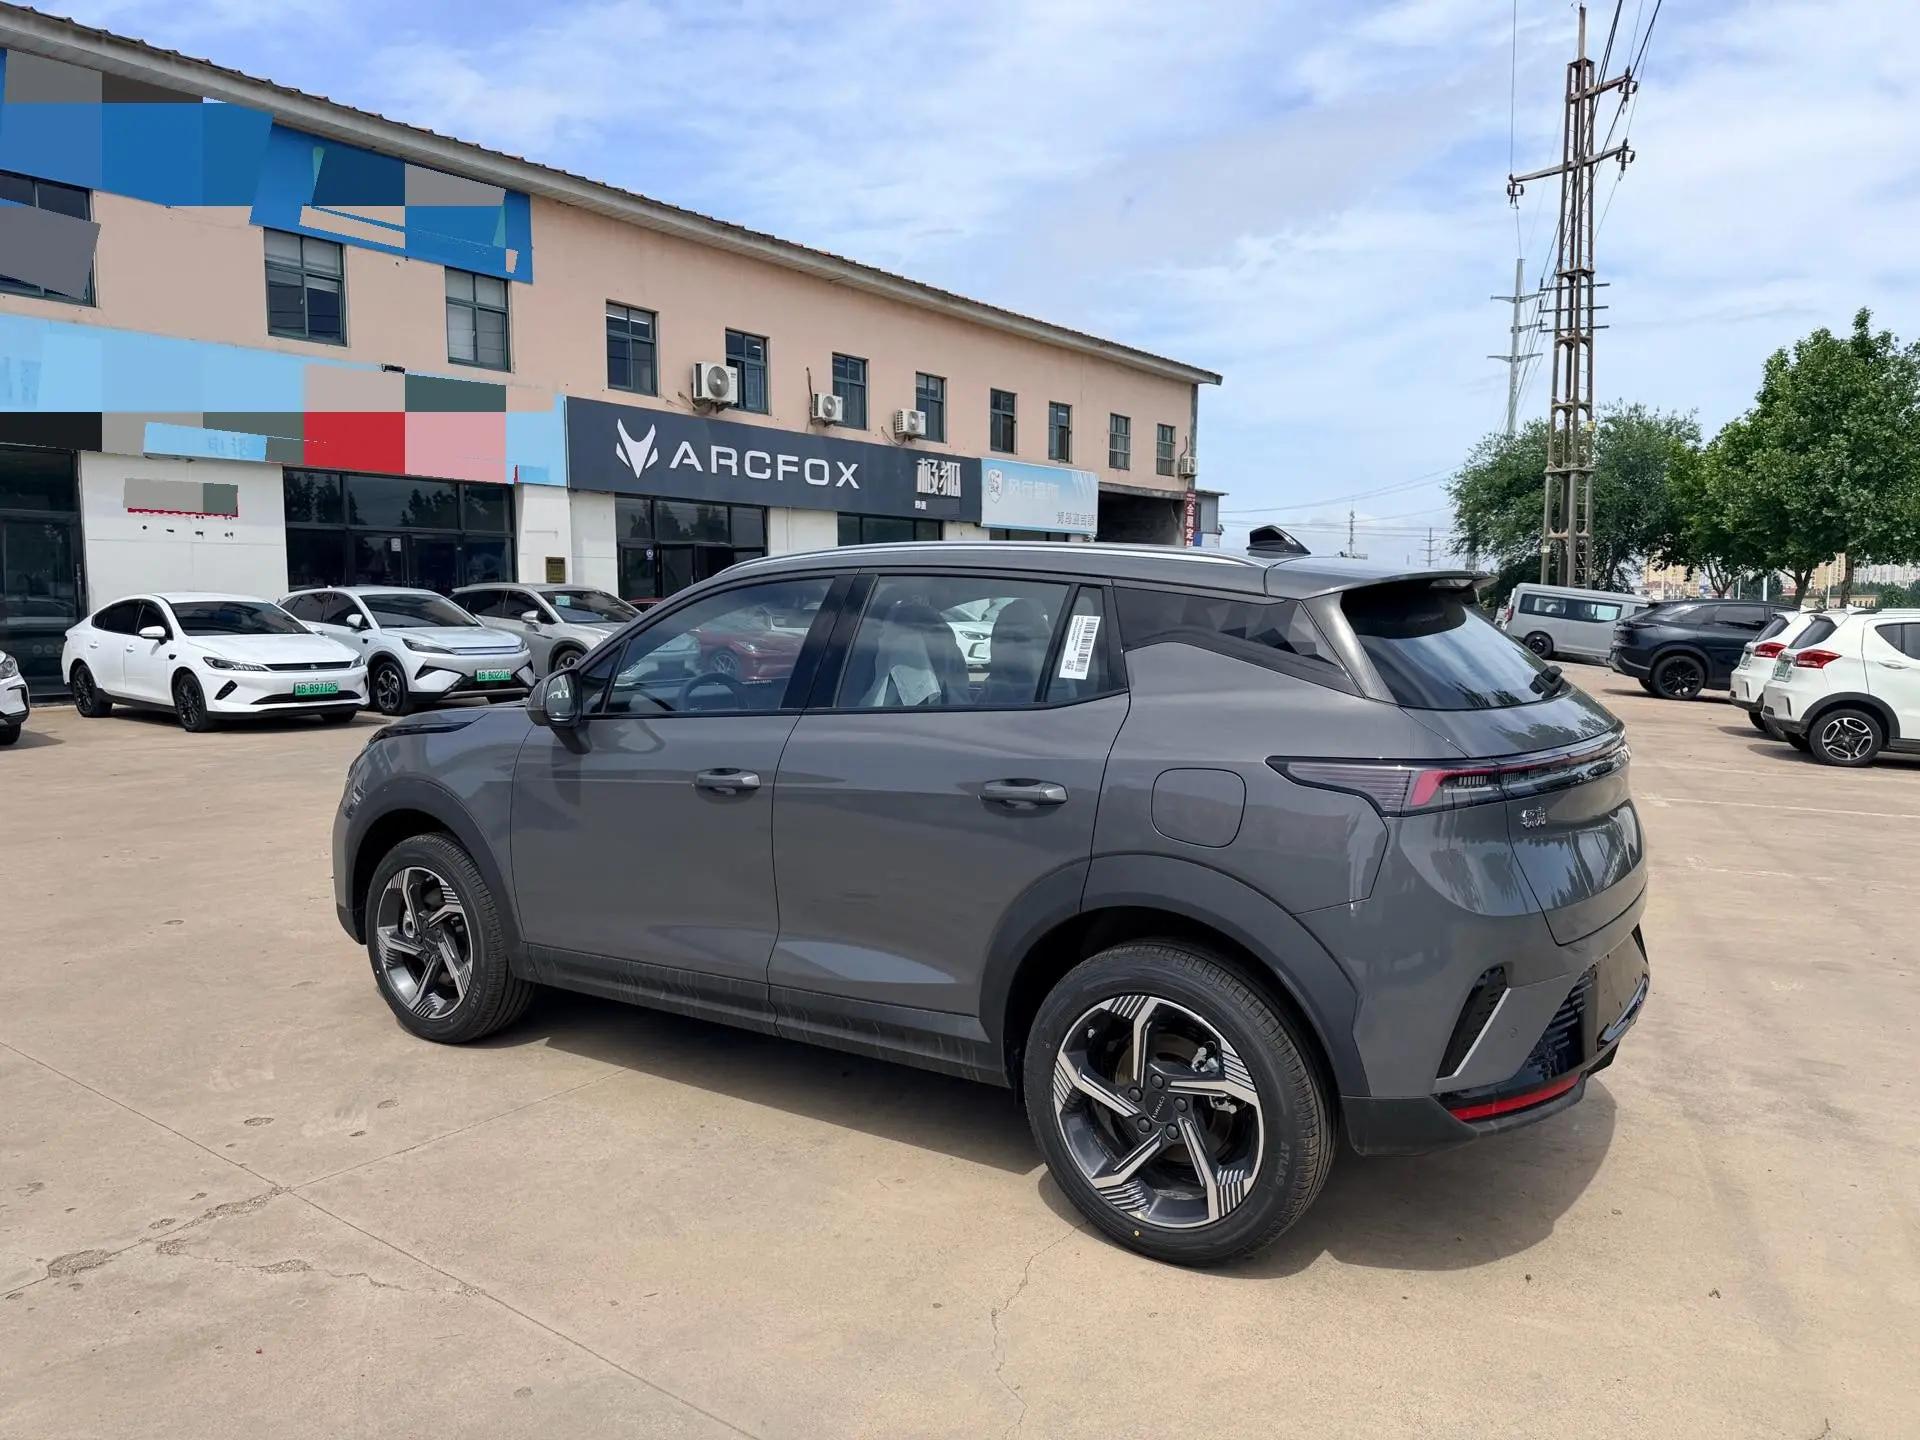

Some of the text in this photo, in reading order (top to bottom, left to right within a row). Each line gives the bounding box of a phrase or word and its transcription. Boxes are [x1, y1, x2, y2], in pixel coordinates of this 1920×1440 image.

[669, 441, 860, 489] ARCFOX
[916, 457, 961, 497] 极狐
[1275, 1140, 1290, 1186] ATLAS
